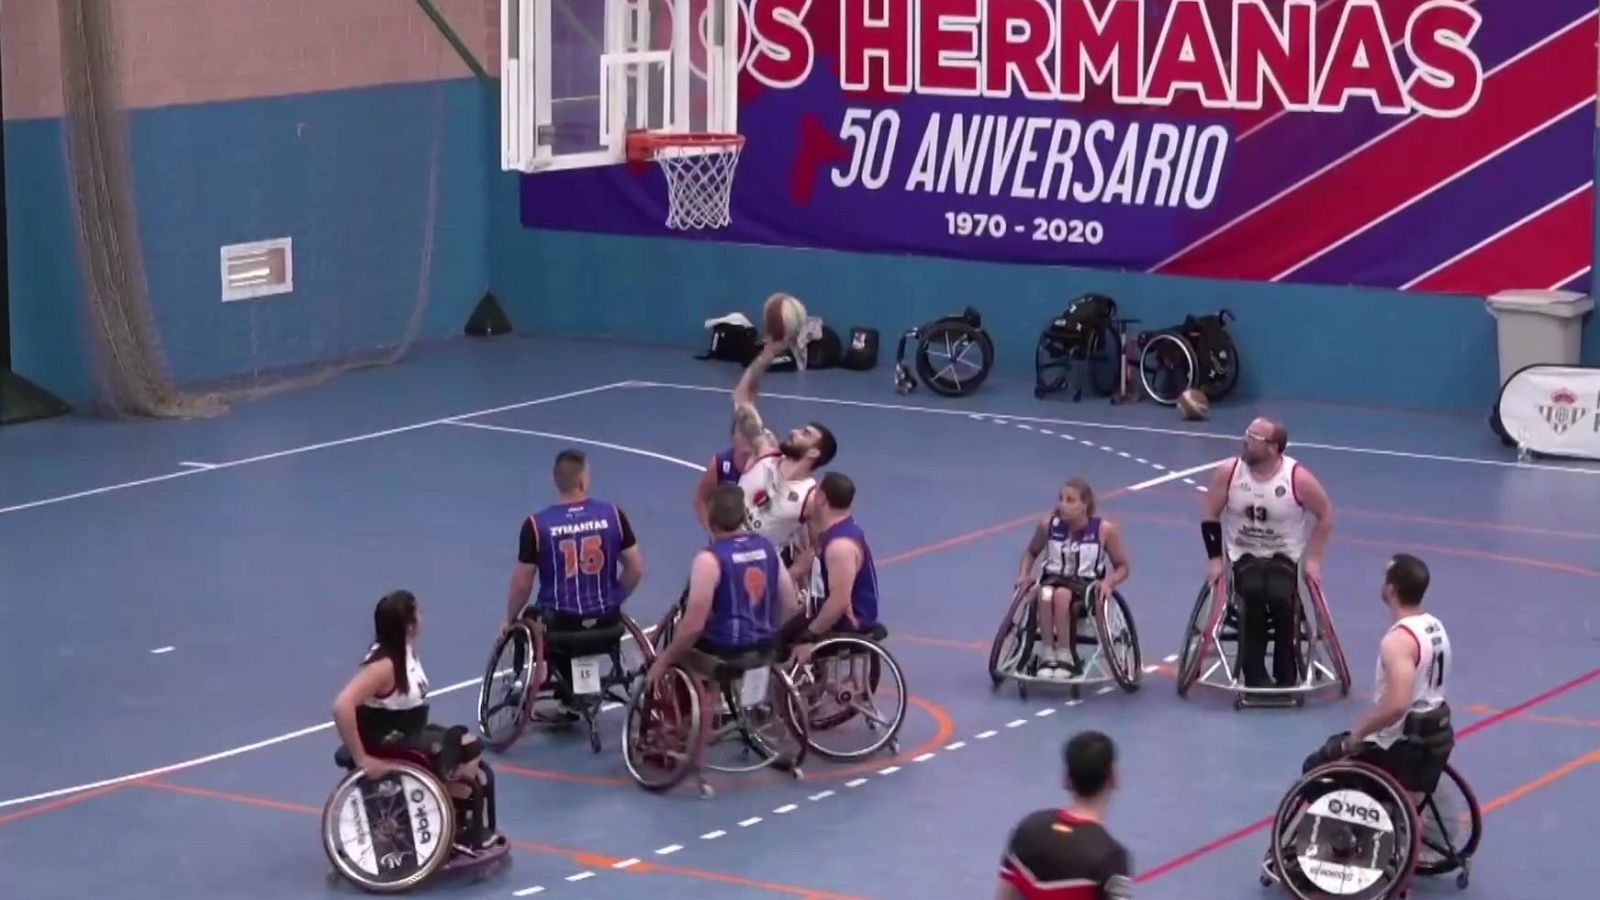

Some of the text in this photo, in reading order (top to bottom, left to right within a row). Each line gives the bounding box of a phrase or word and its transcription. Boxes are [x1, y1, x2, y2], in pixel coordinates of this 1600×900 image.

[840, 0, 1482, 118] HERMANAS
[831, 108, 1229, 209] 50 ANIVERSARIO
[945, 211, 1006, 237] 1970
[1032, 217, 1103, 244] 2020
[558, 535, 605, 579] 15
